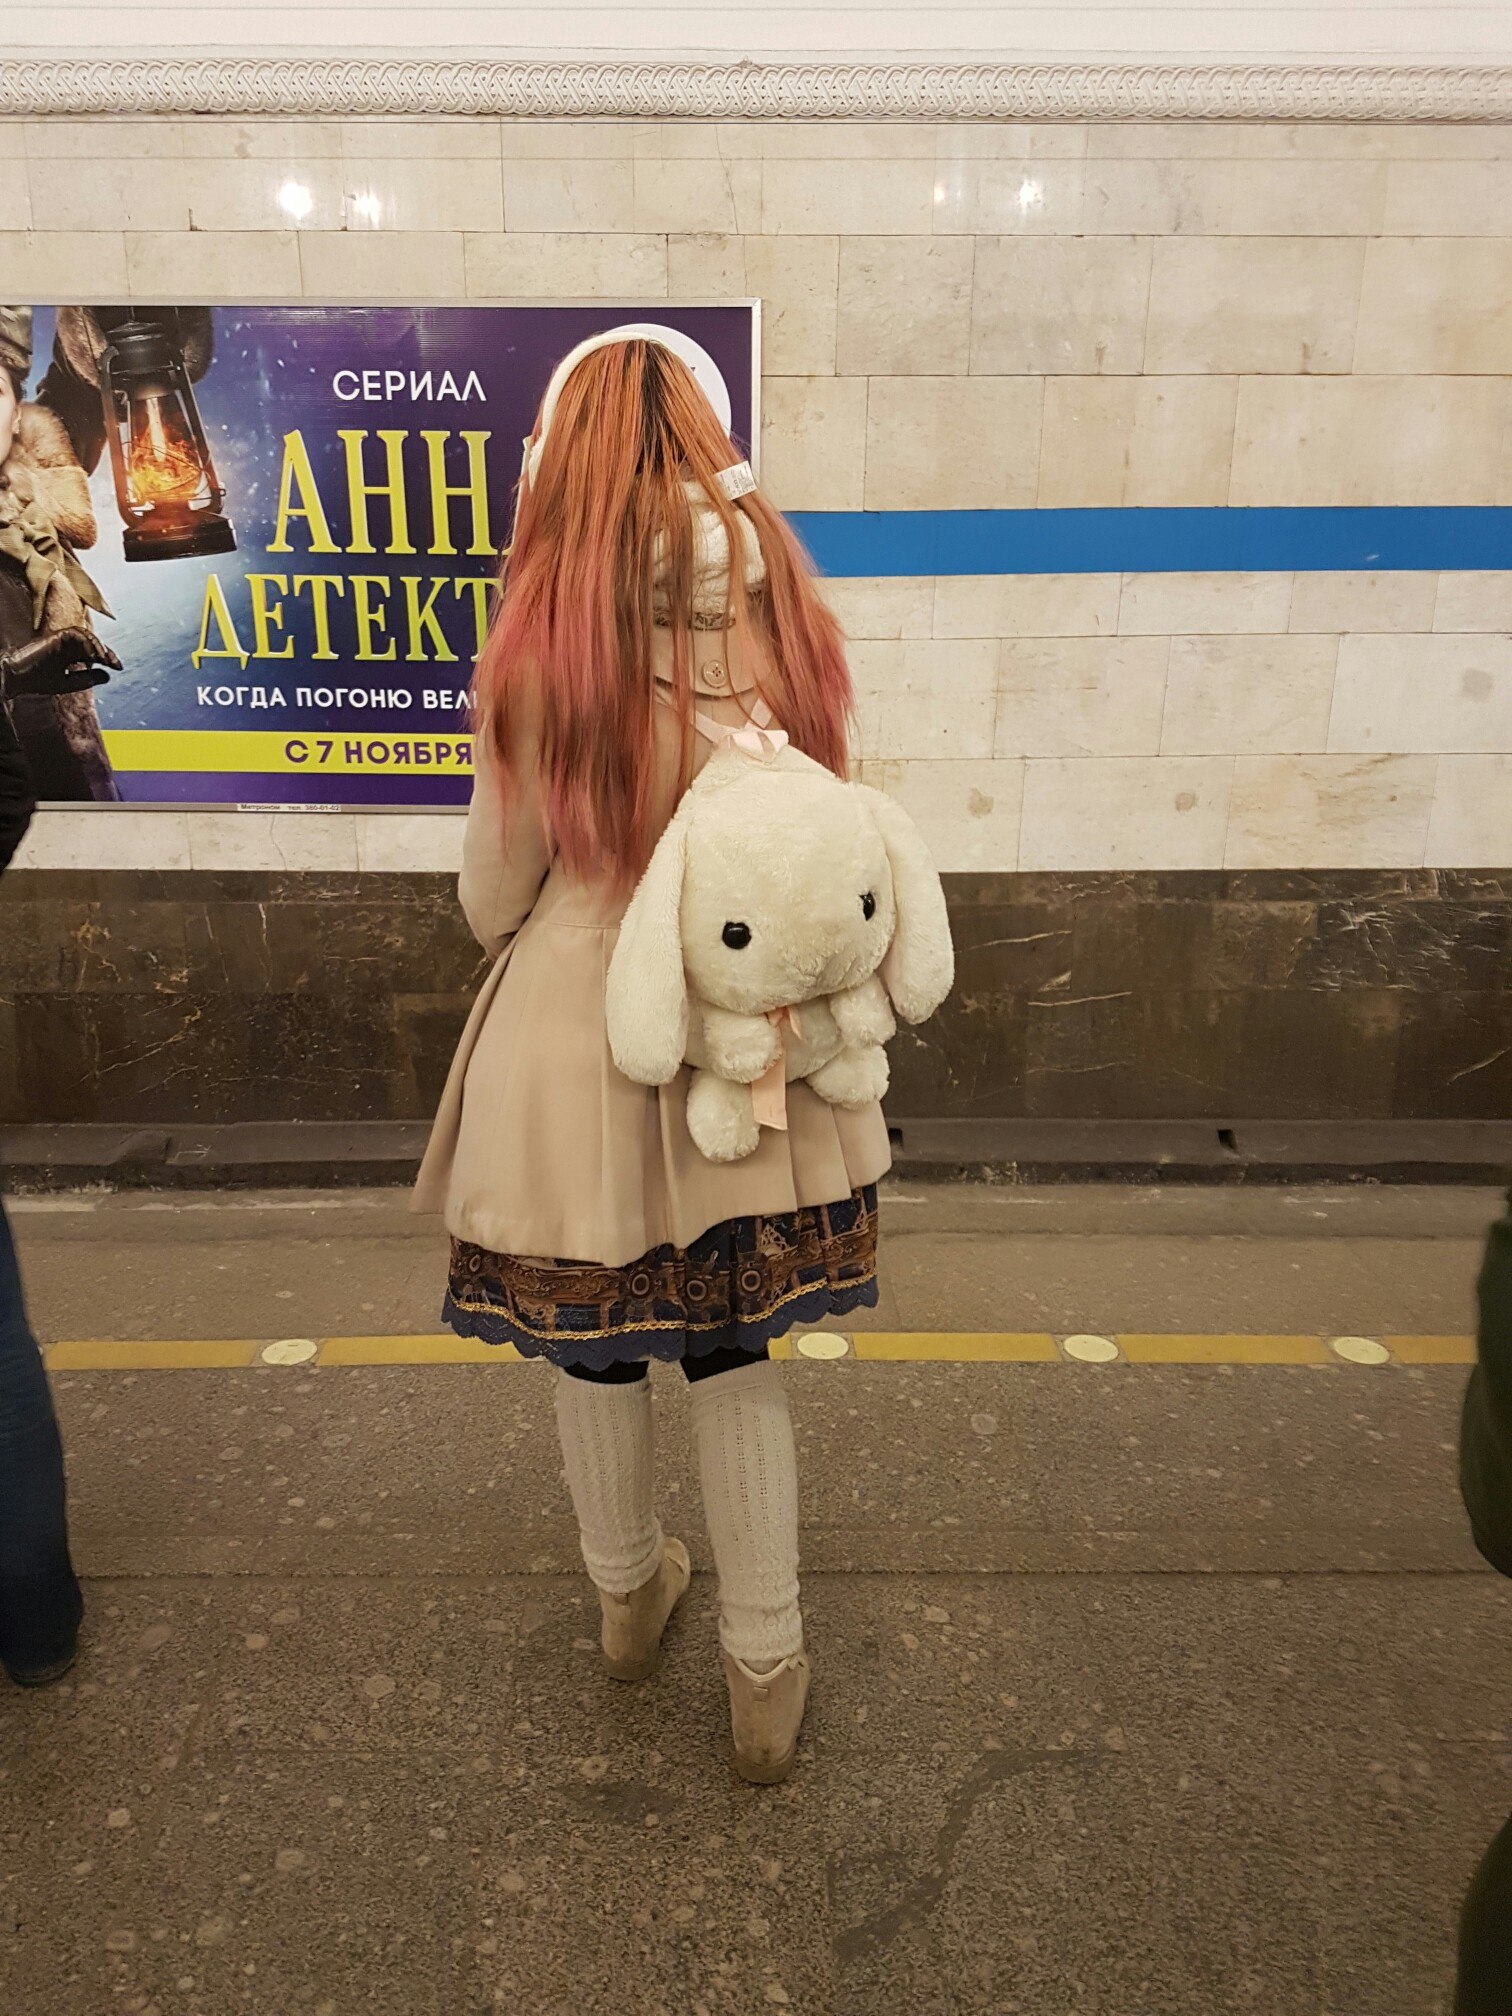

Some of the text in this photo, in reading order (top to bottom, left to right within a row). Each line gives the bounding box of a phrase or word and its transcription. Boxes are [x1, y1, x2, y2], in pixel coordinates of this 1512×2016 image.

[332, 369, 488, 402] СЕРИАЛ
[265, 428, 515, 555] АНН
[196, 686, 287, 708] КОГДА
[296, 687, 413, 709] ПОГОНЮ
[285, 740, 473, 766] С 7 НОЯБРЯ
